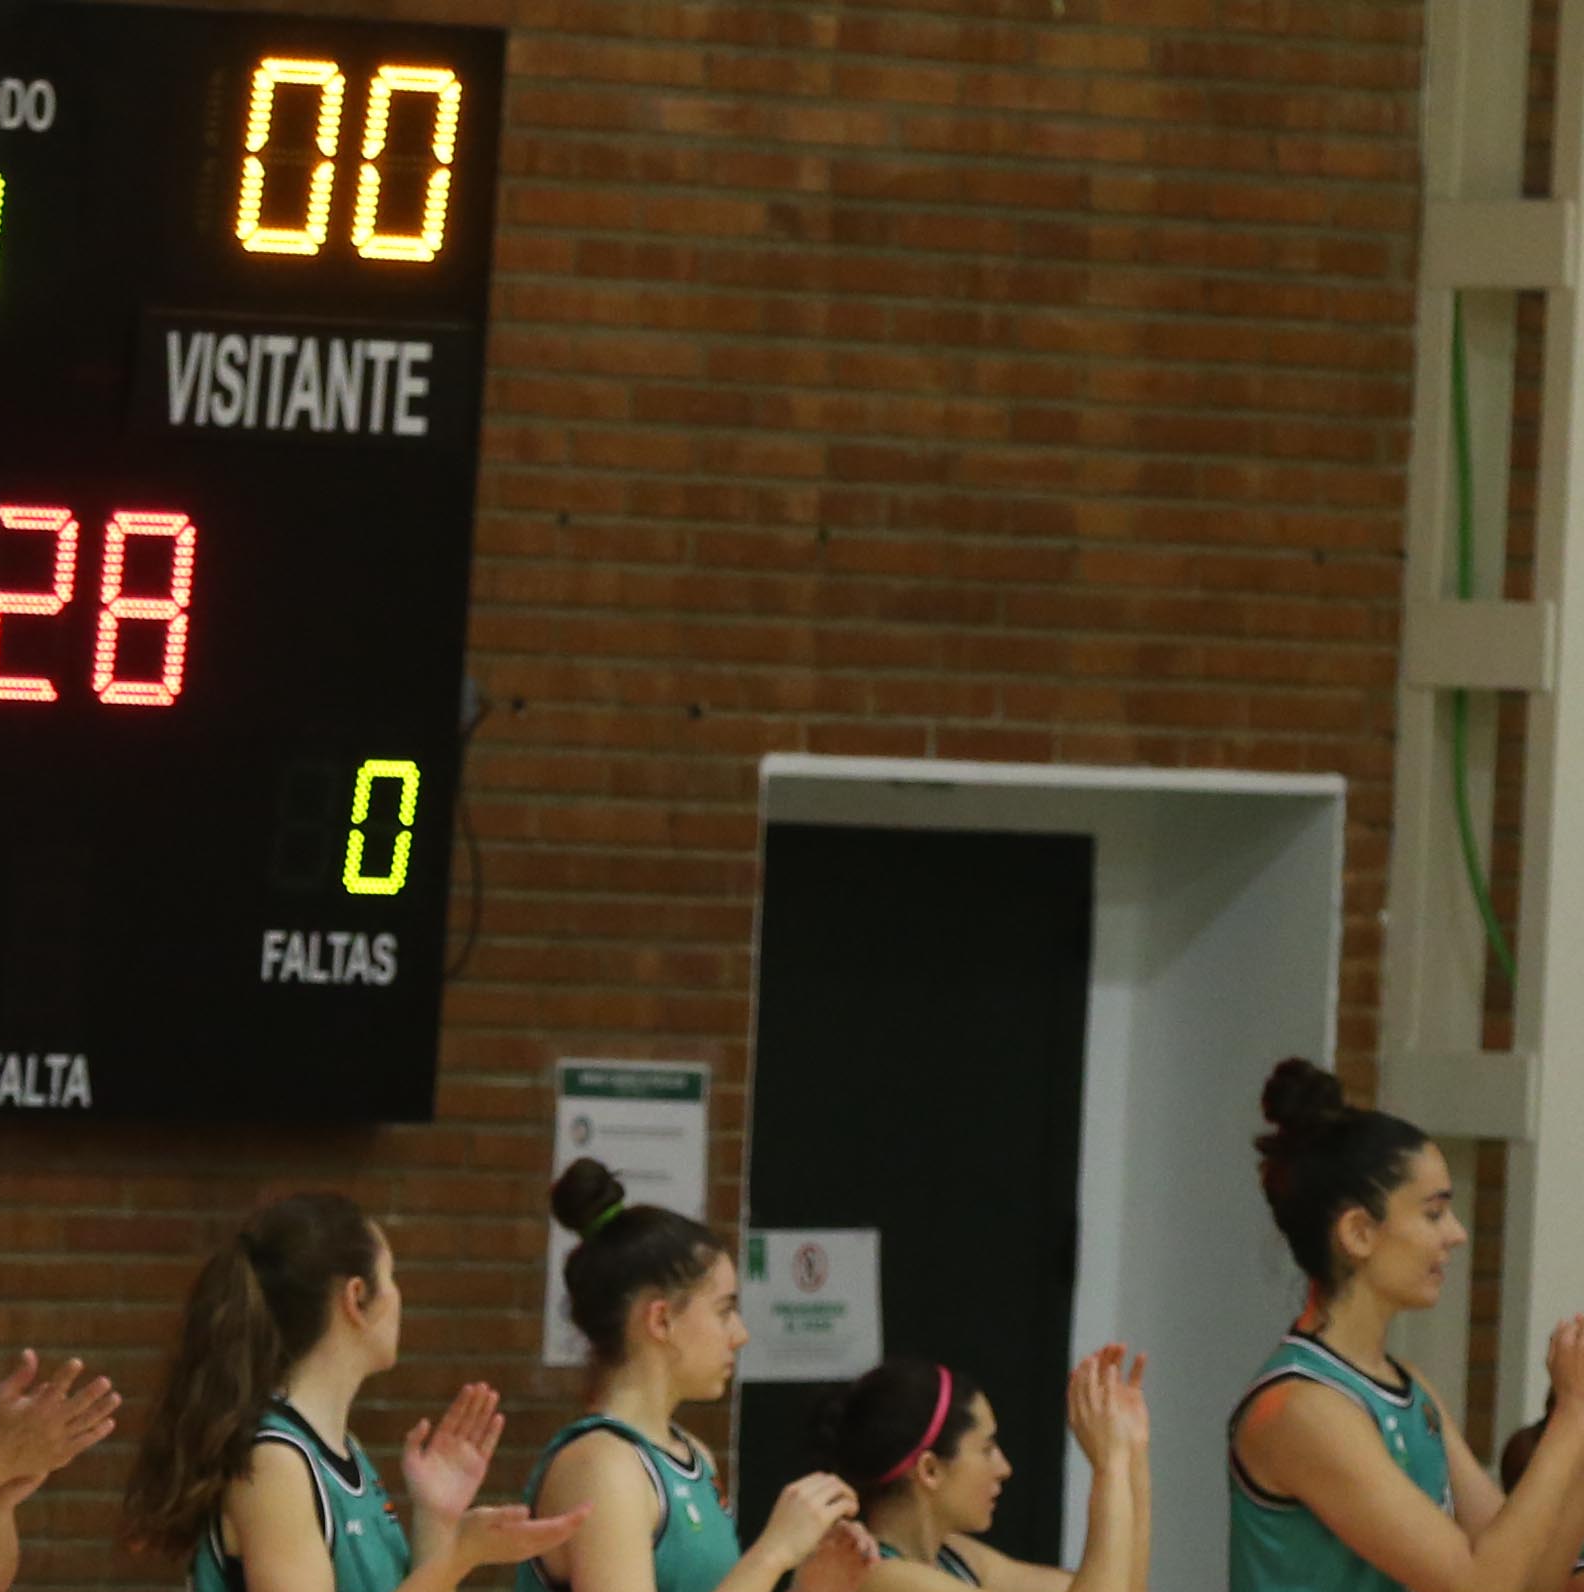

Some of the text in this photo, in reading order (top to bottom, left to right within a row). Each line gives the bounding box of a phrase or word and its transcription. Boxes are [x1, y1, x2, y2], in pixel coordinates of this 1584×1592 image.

[237, 57, 462, 262] 00
[165, 331, 432, 435] VISITANTE
[343, 759, 420, 895] 0
[261, 931, 398, 986] FALTAS
